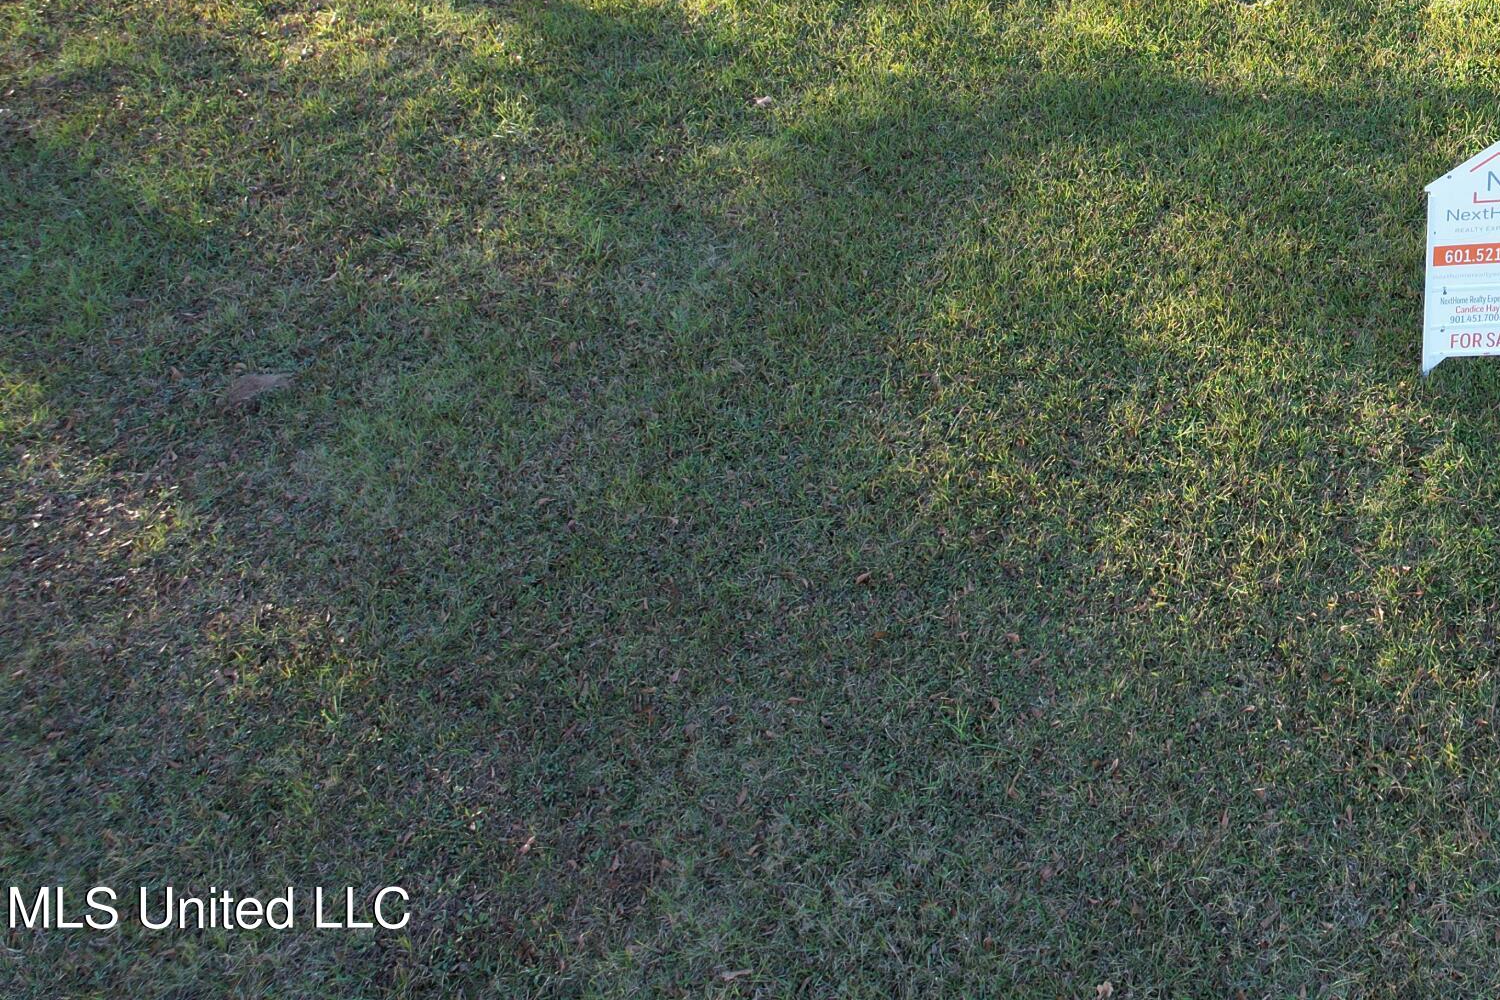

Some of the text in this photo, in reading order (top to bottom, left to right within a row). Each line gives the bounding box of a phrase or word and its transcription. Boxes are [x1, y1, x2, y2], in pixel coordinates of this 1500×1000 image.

[1455, 304, 1500, 314] Candice Hay
[1450, 332, 1482, 349] FOR
